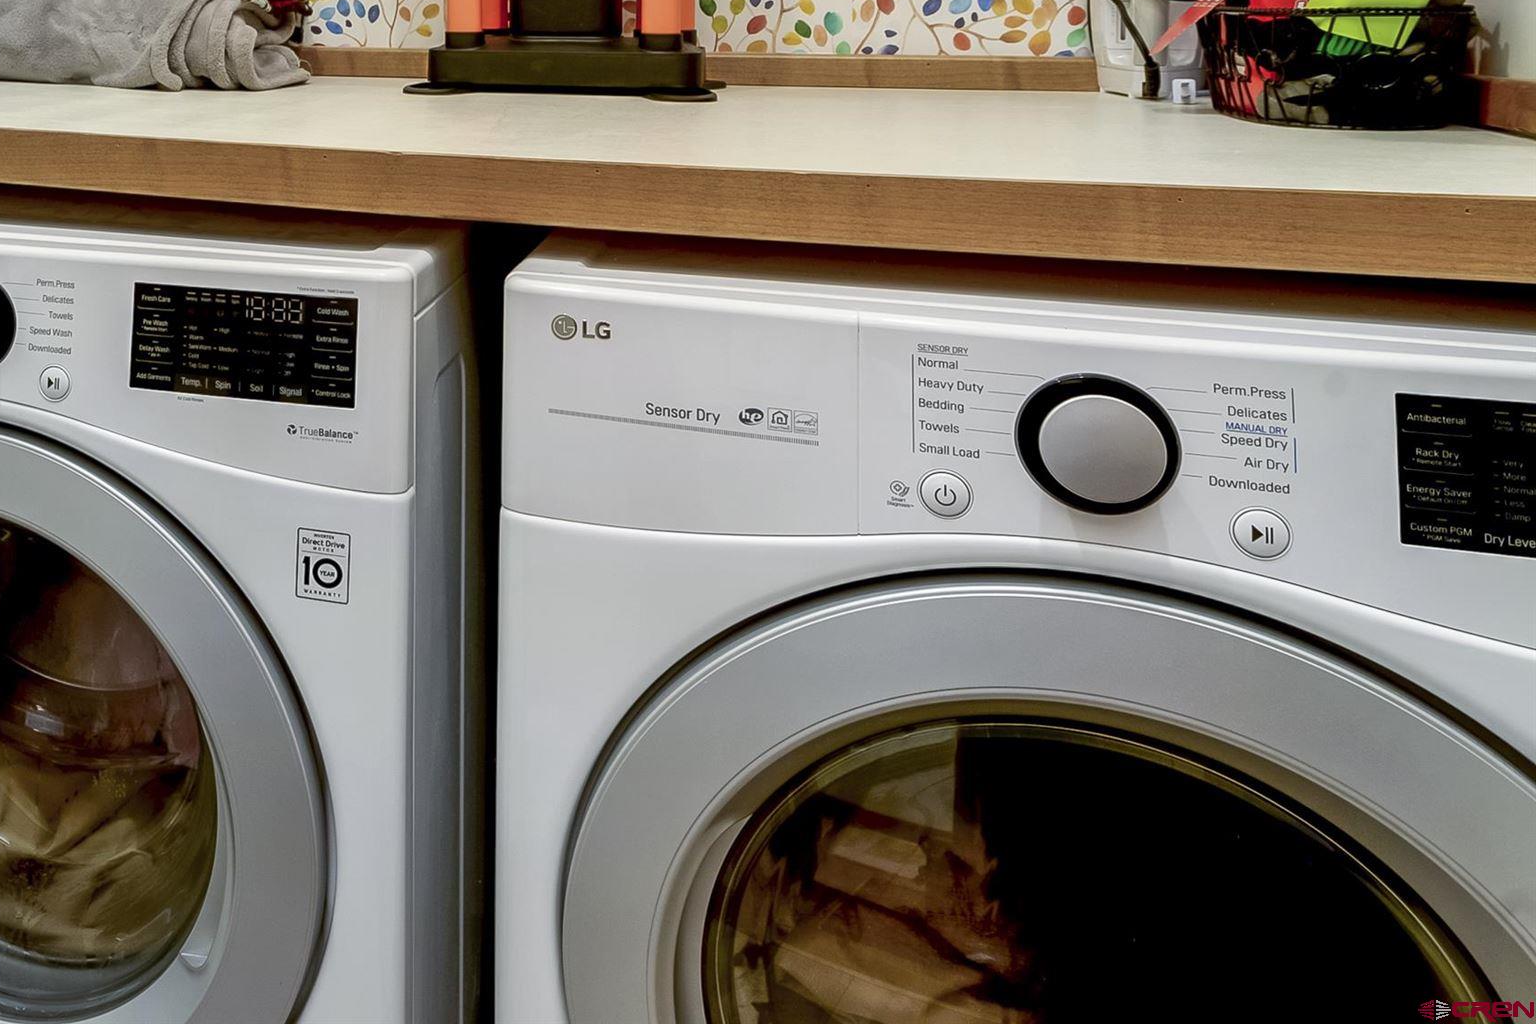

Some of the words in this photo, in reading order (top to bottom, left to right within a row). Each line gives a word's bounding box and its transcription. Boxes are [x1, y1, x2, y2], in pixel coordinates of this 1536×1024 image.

[42, 295, 75, 304] Delicates
[49, 311, 74, 320] Towels
[317, 307, 331, 315] Cold
[332, 308, 350, 316] Wash
[29, 326, 51, 336] Speed
[52, 328, 73, 337] Wash
[582, 320, 611, 340] LG
[316, 335, 332, 343] Extra
[28, 343, 72, 355] Downloaded
[917, 344, 950, 354] SENSOR
[952, 346, 969, 355] DRY
[336, 363, 350, 372] Spin
[917, 357, 959, 370] Normal
[181, 377, 202, 387] Temp.
[215, 380, 232, 390] Spin
[250, 383, 264, 392] Soil
[918, 377, 954, 391] Heavy
[957, 381, 984, 394] Duty
[279, 386, 303, 397] Signal
[315, 389, 336, 398] Control
[918, 398, 965, 413] Bedding
[645, 402, 693, 420] Sensor
[696, 407, 721, 425] Dry
[1227, 405, 1288, 421] Delicates
[1407, 412, 1467, 425] Antibacterial
[918, 420, 960, 434] Towels
[1225, 421, 1266, 433] MANUAL
[1268, 425, 1288, 435] DRY
[1221, 433, 1262, 448] Speed
[1265, 437, 1288, 452] Dry
[919, 443, 950, 456] Small
[953, 446, 980, 459] Load
[1416, 447, 1440, 458] Rack
[1442, 450, 1460, 461] Dry
[1244, 457, 1263, 469] Air
[1266, 459, 1290, 473] Dry
[1209, 475, 1291, 494] Downloaded
[1406, 483, 1441, 497] Energy
[1443, 487, 1472, 498] Saver
[1410, 522, 1448, 534] Custom
[1450, 526, 1473, 536] PGM
[302, 536, 325, 547] Direct
[325, 540, 345, 549] Drive
[1484, 533, 1505, 547] Dry
[302, 556, 343, 589] 10
[319, 570, 335, 578] YEAR
[304, 589, 341, 598] WARRANTY
